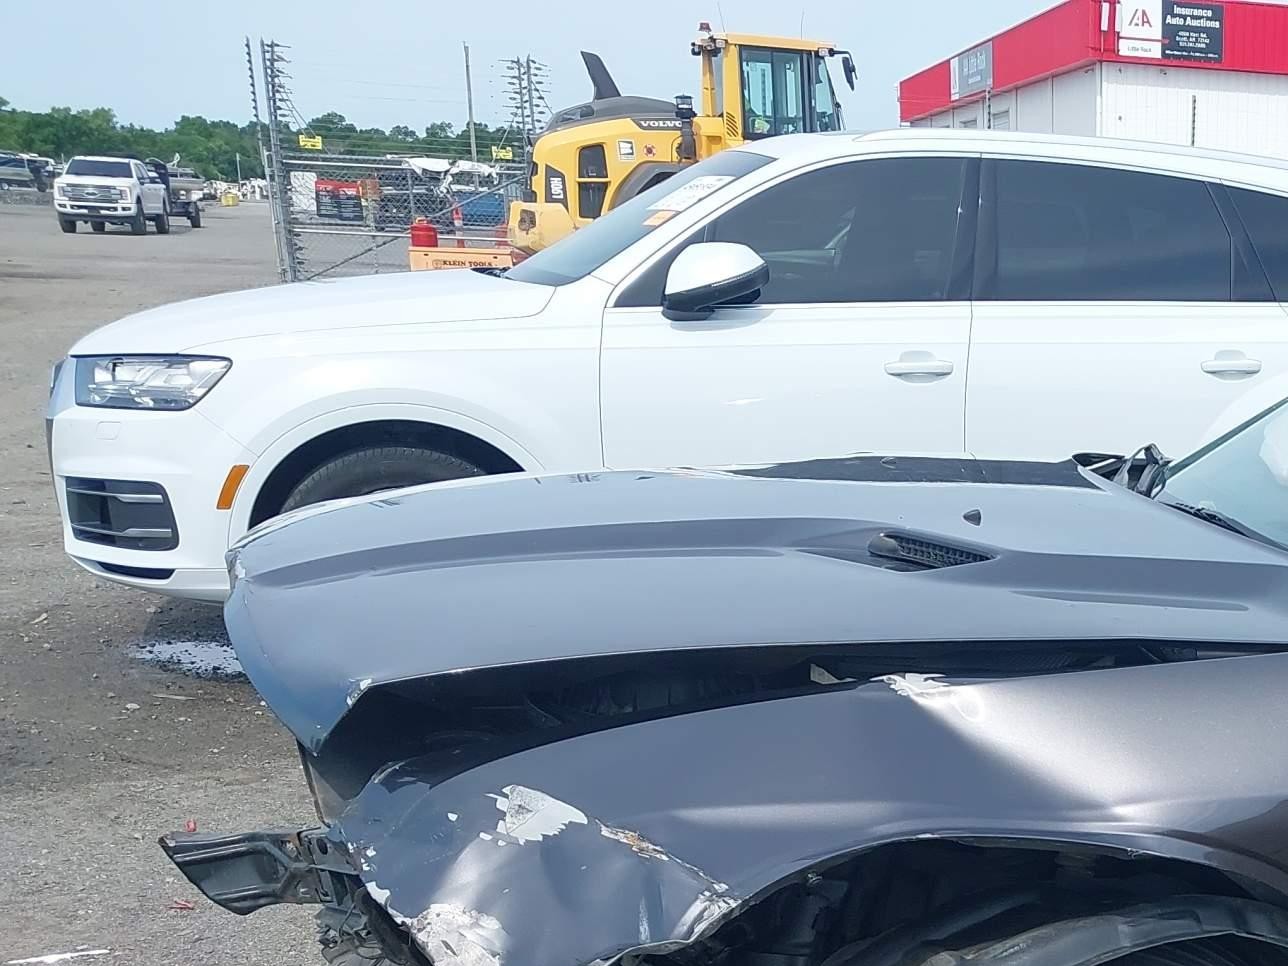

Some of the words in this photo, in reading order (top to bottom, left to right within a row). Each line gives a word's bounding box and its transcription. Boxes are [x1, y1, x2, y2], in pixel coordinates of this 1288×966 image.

[1173, 5, 1213, 17] Insurance
[1165, 14, 1185, 25] Auto
[1185, 16, 1220, 28] Auctions
[639, 120, 683, 128] VOLVO
[549, 177, 564, 199] L90H
